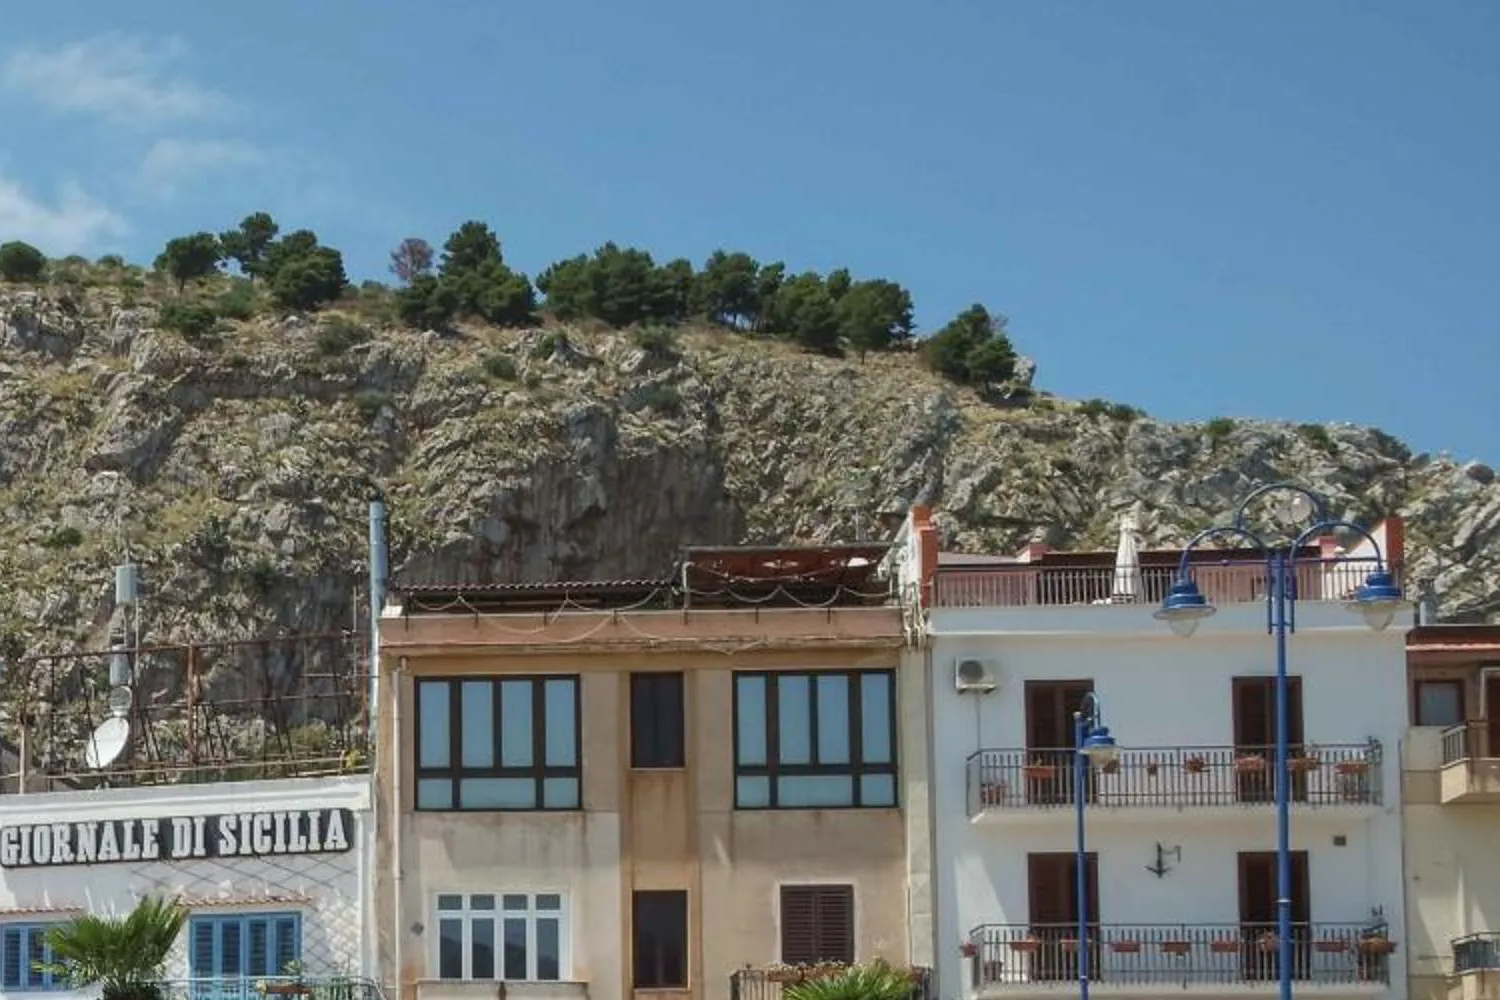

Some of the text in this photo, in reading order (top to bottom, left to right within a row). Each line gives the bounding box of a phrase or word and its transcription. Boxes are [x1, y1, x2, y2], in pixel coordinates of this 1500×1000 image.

[1, 809, 349, 866] GIORNALE DI SICILIA
